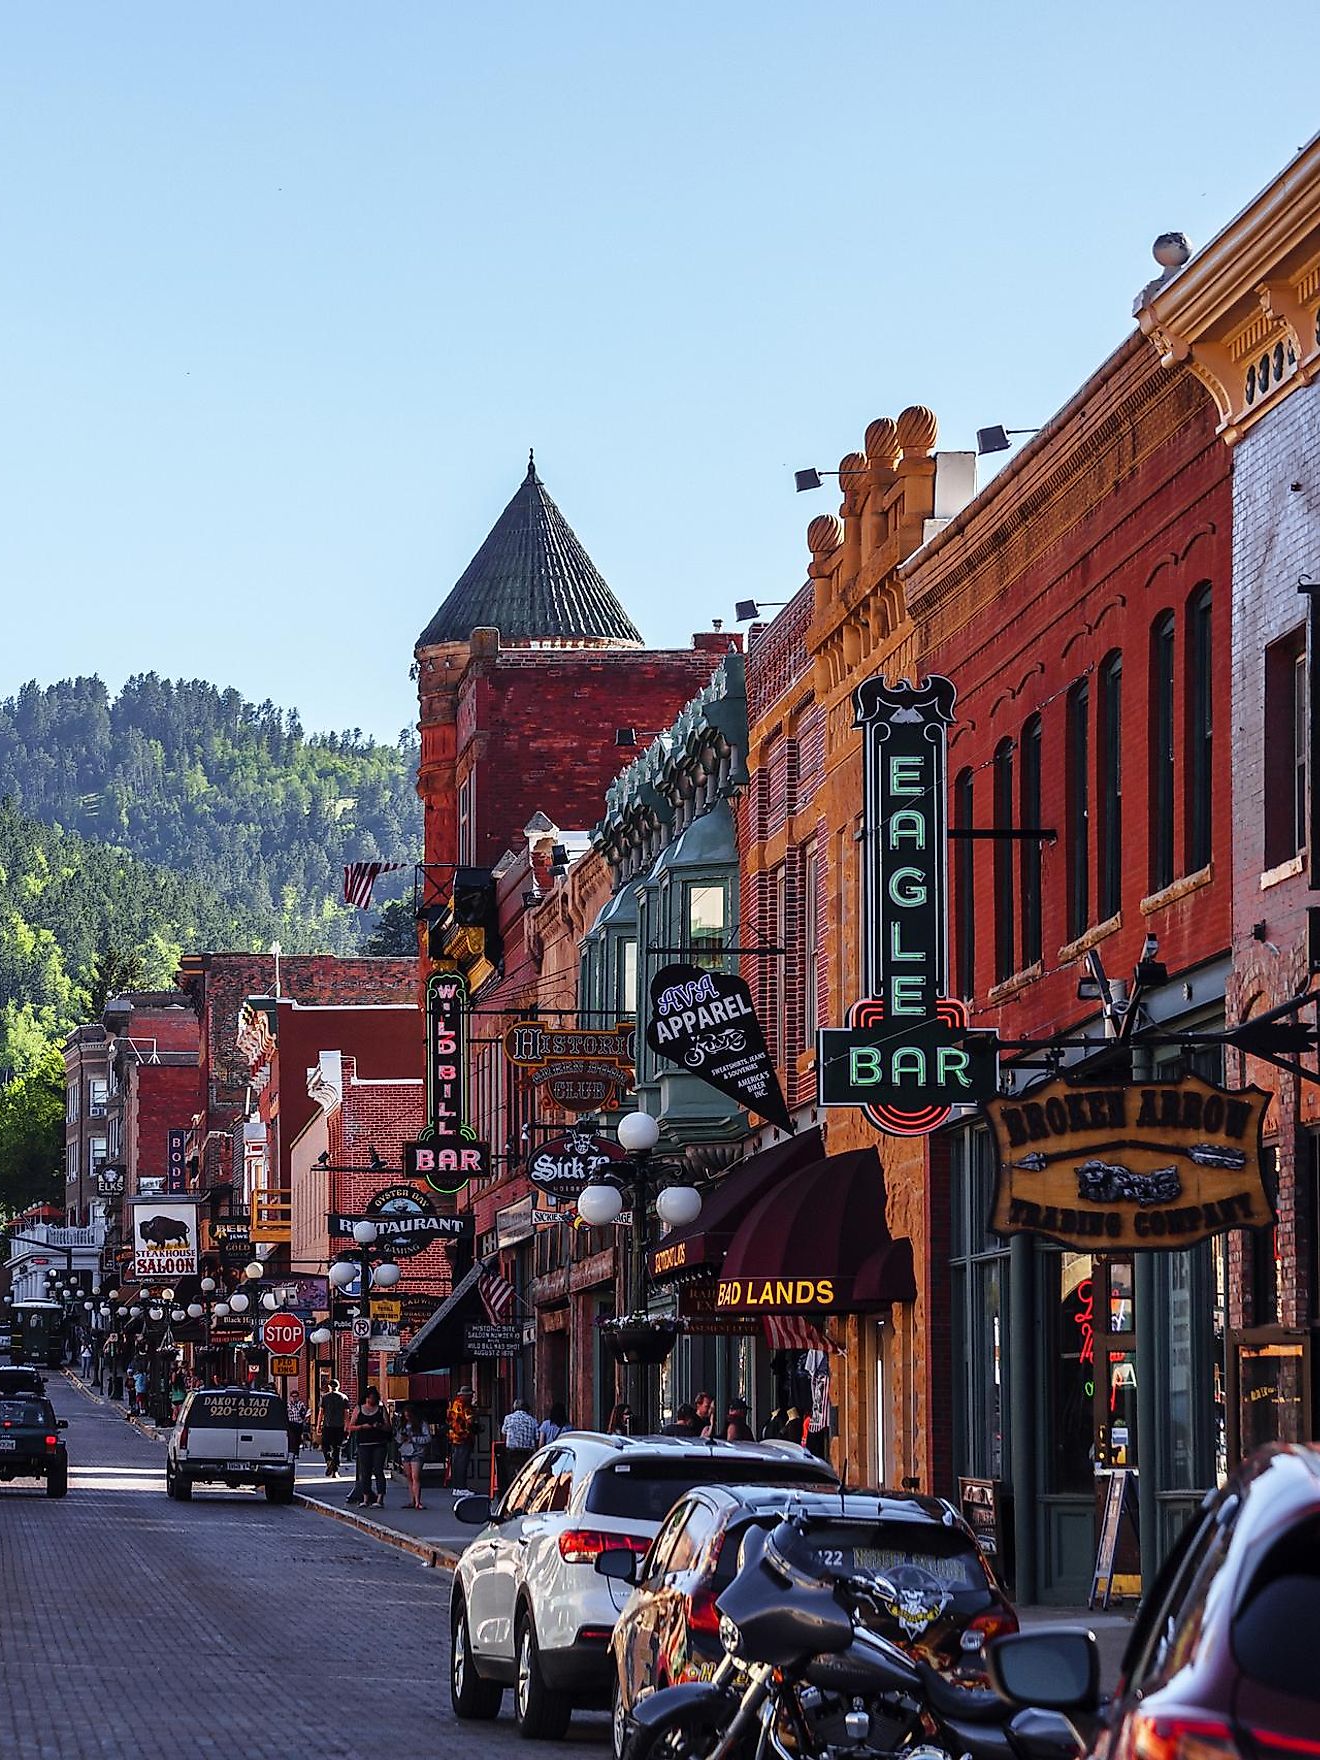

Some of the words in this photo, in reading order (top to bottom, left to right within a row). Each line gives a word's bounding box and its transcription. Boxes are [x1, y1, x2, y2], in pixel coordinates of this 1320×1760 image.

[889, 756, 927, 1016] EAGLE
[657, 974, 720, 1015] AVA
[437, 984, 457, 1055] WILD
[656, 993, 752, 1044] APPAREL
[711, 1058, 750, 1076] SWEATSHIRTS,
[748, 1052, 766, 1062] JEANS
[727, 1063, 759, 1079] SOUVENIRS
[850, 1046, 973, 1088] BAR
[738, 1071, 770, 1088] AMERICA'S
[747, 1081, 767, 1093] BIKER
[553, 1081, 606, 1099] CLUB
[754, 1089, 769, 1099] INC.
[438, 1065, 457, 1135] BILL
[1001, 1089, 1127, 1148] BROKEN
[1136, 1089, 1253, 1139] ARROW
[415, 1149, 481, 1171] BAR
[531, 1153, 585, 1182] Sick
[98, 1182, 124, 1191] ELKS
[374, 1189, 410, 1208] OYSTER
[1010, 1199, 1122, 1238] TRADING
[1134, 1192, 1255, 1238] COMPANY
[216, 1224, 249, 1233] BER
[340, 1218, 464, 1235] RTAURANT
[136, 1249, 196, 1258] STEAKHOUSE
[383, 1243, 421, 1255] GAMING
[137, 1258, 196, 1274] SALOON
[716, 1282, 742, 1307] BAD
[746, 1280, 835, 1305] LANDS
[266, 1326, 302, 1342] STOP
[249, 1398, 270, 1407] TAXI
[210, 1406, 268, 1418] 920-2020
